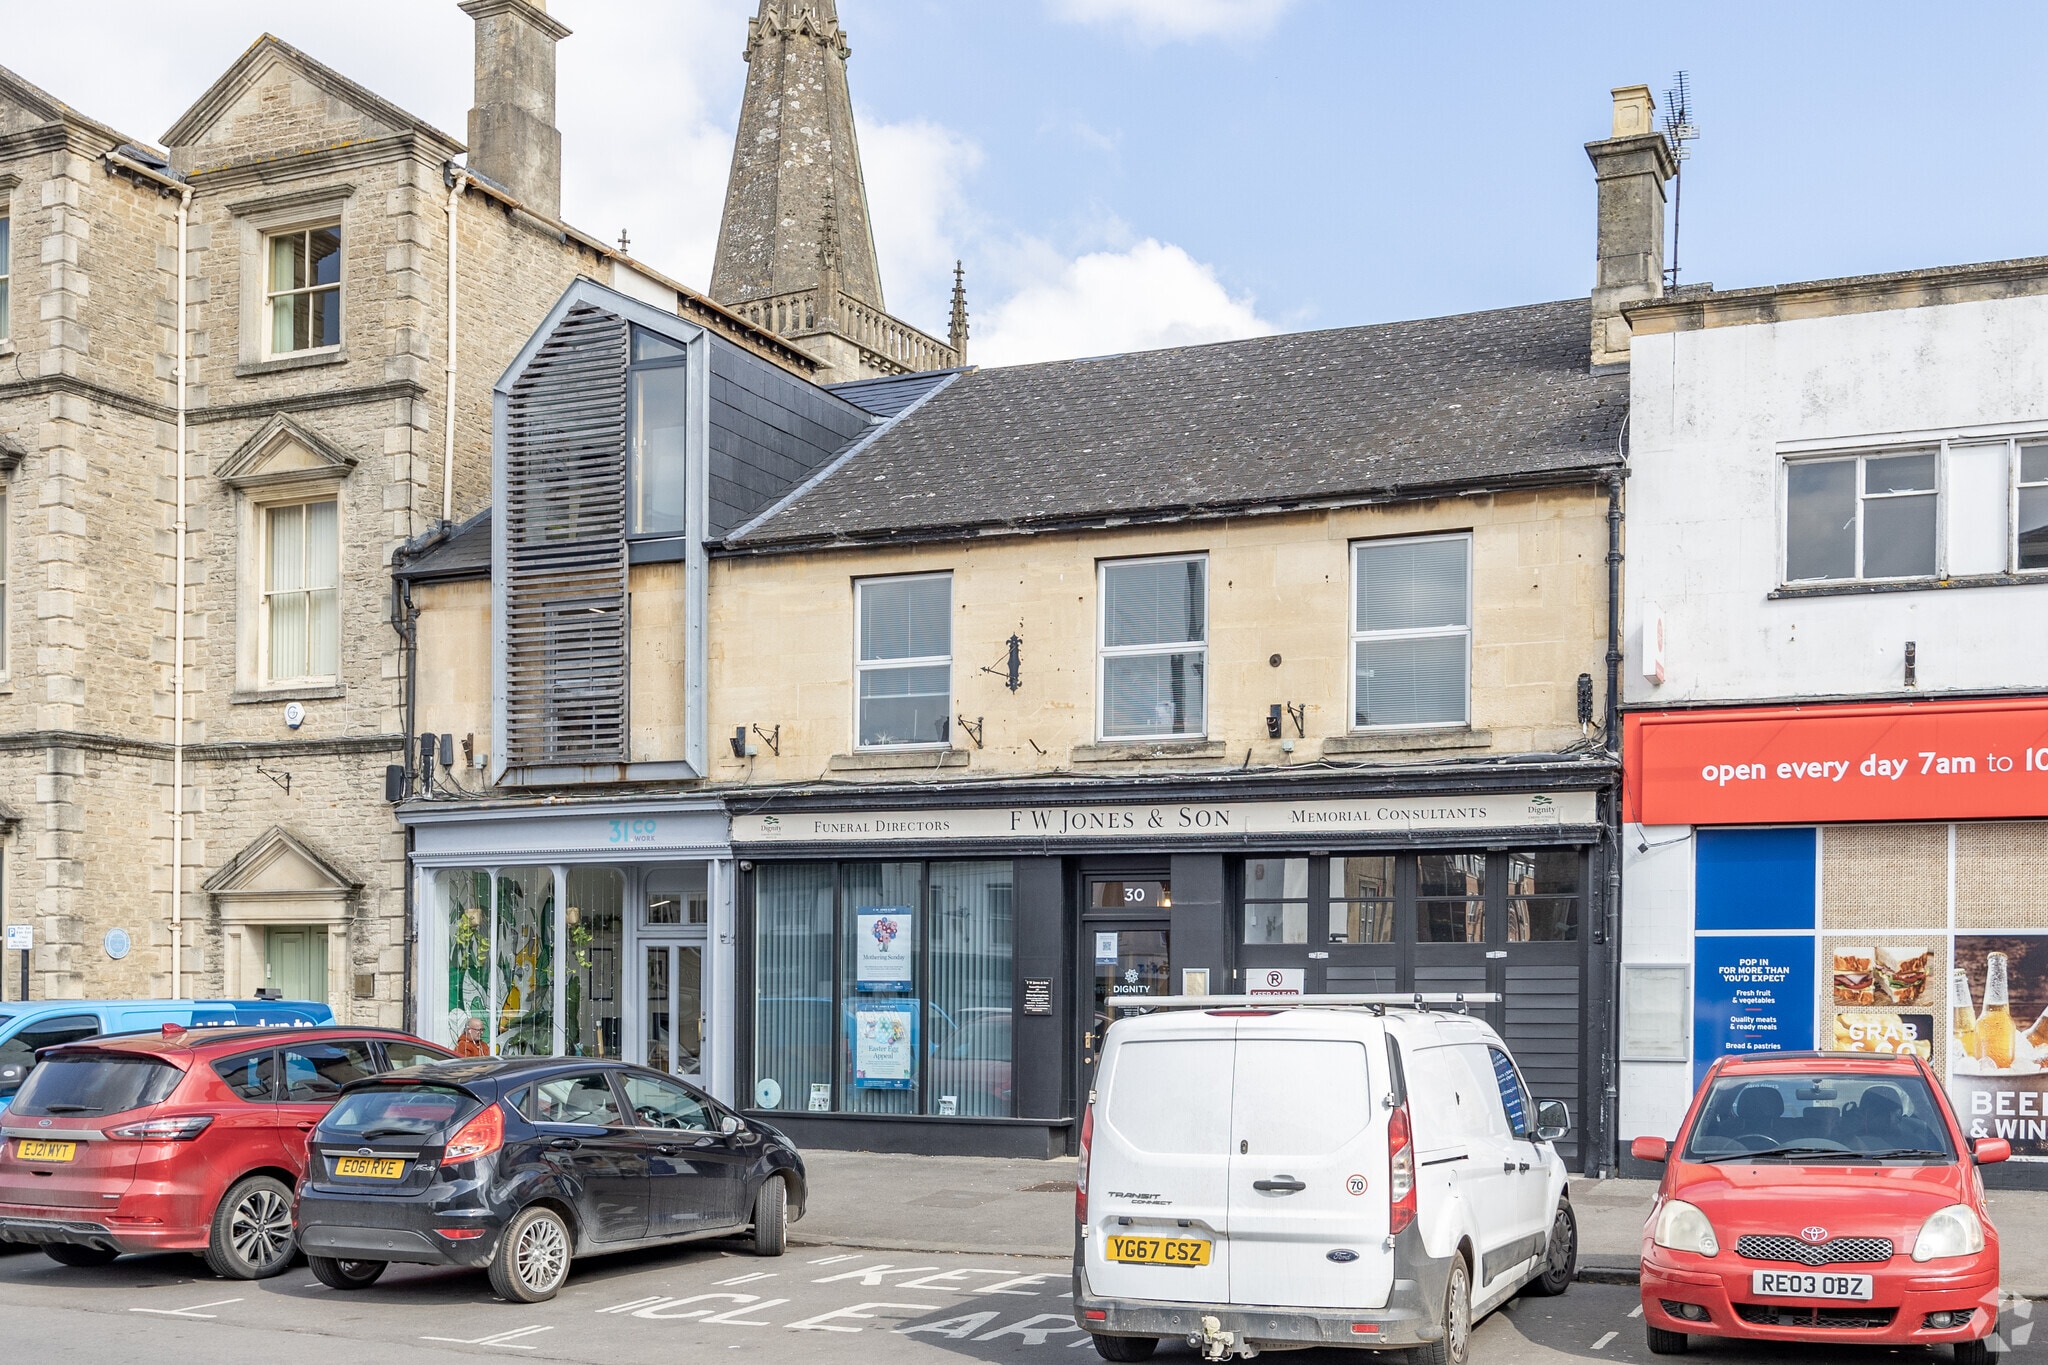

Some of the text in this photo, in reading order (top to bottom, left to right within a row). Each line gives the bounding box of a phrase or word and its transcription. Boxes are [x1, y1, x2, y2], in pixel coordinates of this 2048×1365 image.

[1701, 762, 1766, 786] open
[1776, 760, 1850, 782] every
[1859, 753, 1908, 780] day
[1918, 752, 1976, 775] 7am
[1986, 752, 2013, 772] to
[1291, 807, 1487, 823] MEMORIAL CONSULTANTS
[1527, 806, 1556, 815] Dignity
[1010, 806, 1230, 834] F W JONES & SON
[814, 820, 950, 833] FUNERAL DIRECTORS
[1124, 888, 1145, 902] 30
[863, 954, 905, 962] Mothering Sunday
[1739, 958, 1769, 966] POP IN
[1719, 966, 1790, 974] FOR MORE THAN
[1723, 974, 1785, 982] YOU'D EXPECT
[1113, 985, 1151, 994] DIGNITY
[1736, 989, 1771, 997] Fresh fruit
[1730, 1016, 1754, 1024] Quality
[1736, 1023, 1756, 1031] ready
[1848, 1023, 1918, 1041] GRAB
[887, 1045, 899, 1053] Egg
[1753, 1042, 1781, 1050] pastries
[873, 1053, 894, 1061] Appeal
[1971, 1091, 2048, 1117] BEE
[1970, 1118, 1989, 1139] &
[371, 1161, 396, 1175] RVE
[1350, 1181, 1364, 1191] 70
[1108, 1191, 1162, 1200] TRANSIT
[1114, 1239, 1202, 1262] YG67 CSZ
[1332, 1250, 1353, 1261] Ford
[810, 1264, 1074, 1298] KEE
[1762, 1273, 1863, 1296] RE03 OBZ
[631, 1293, 1084, 1346] CLEAR
